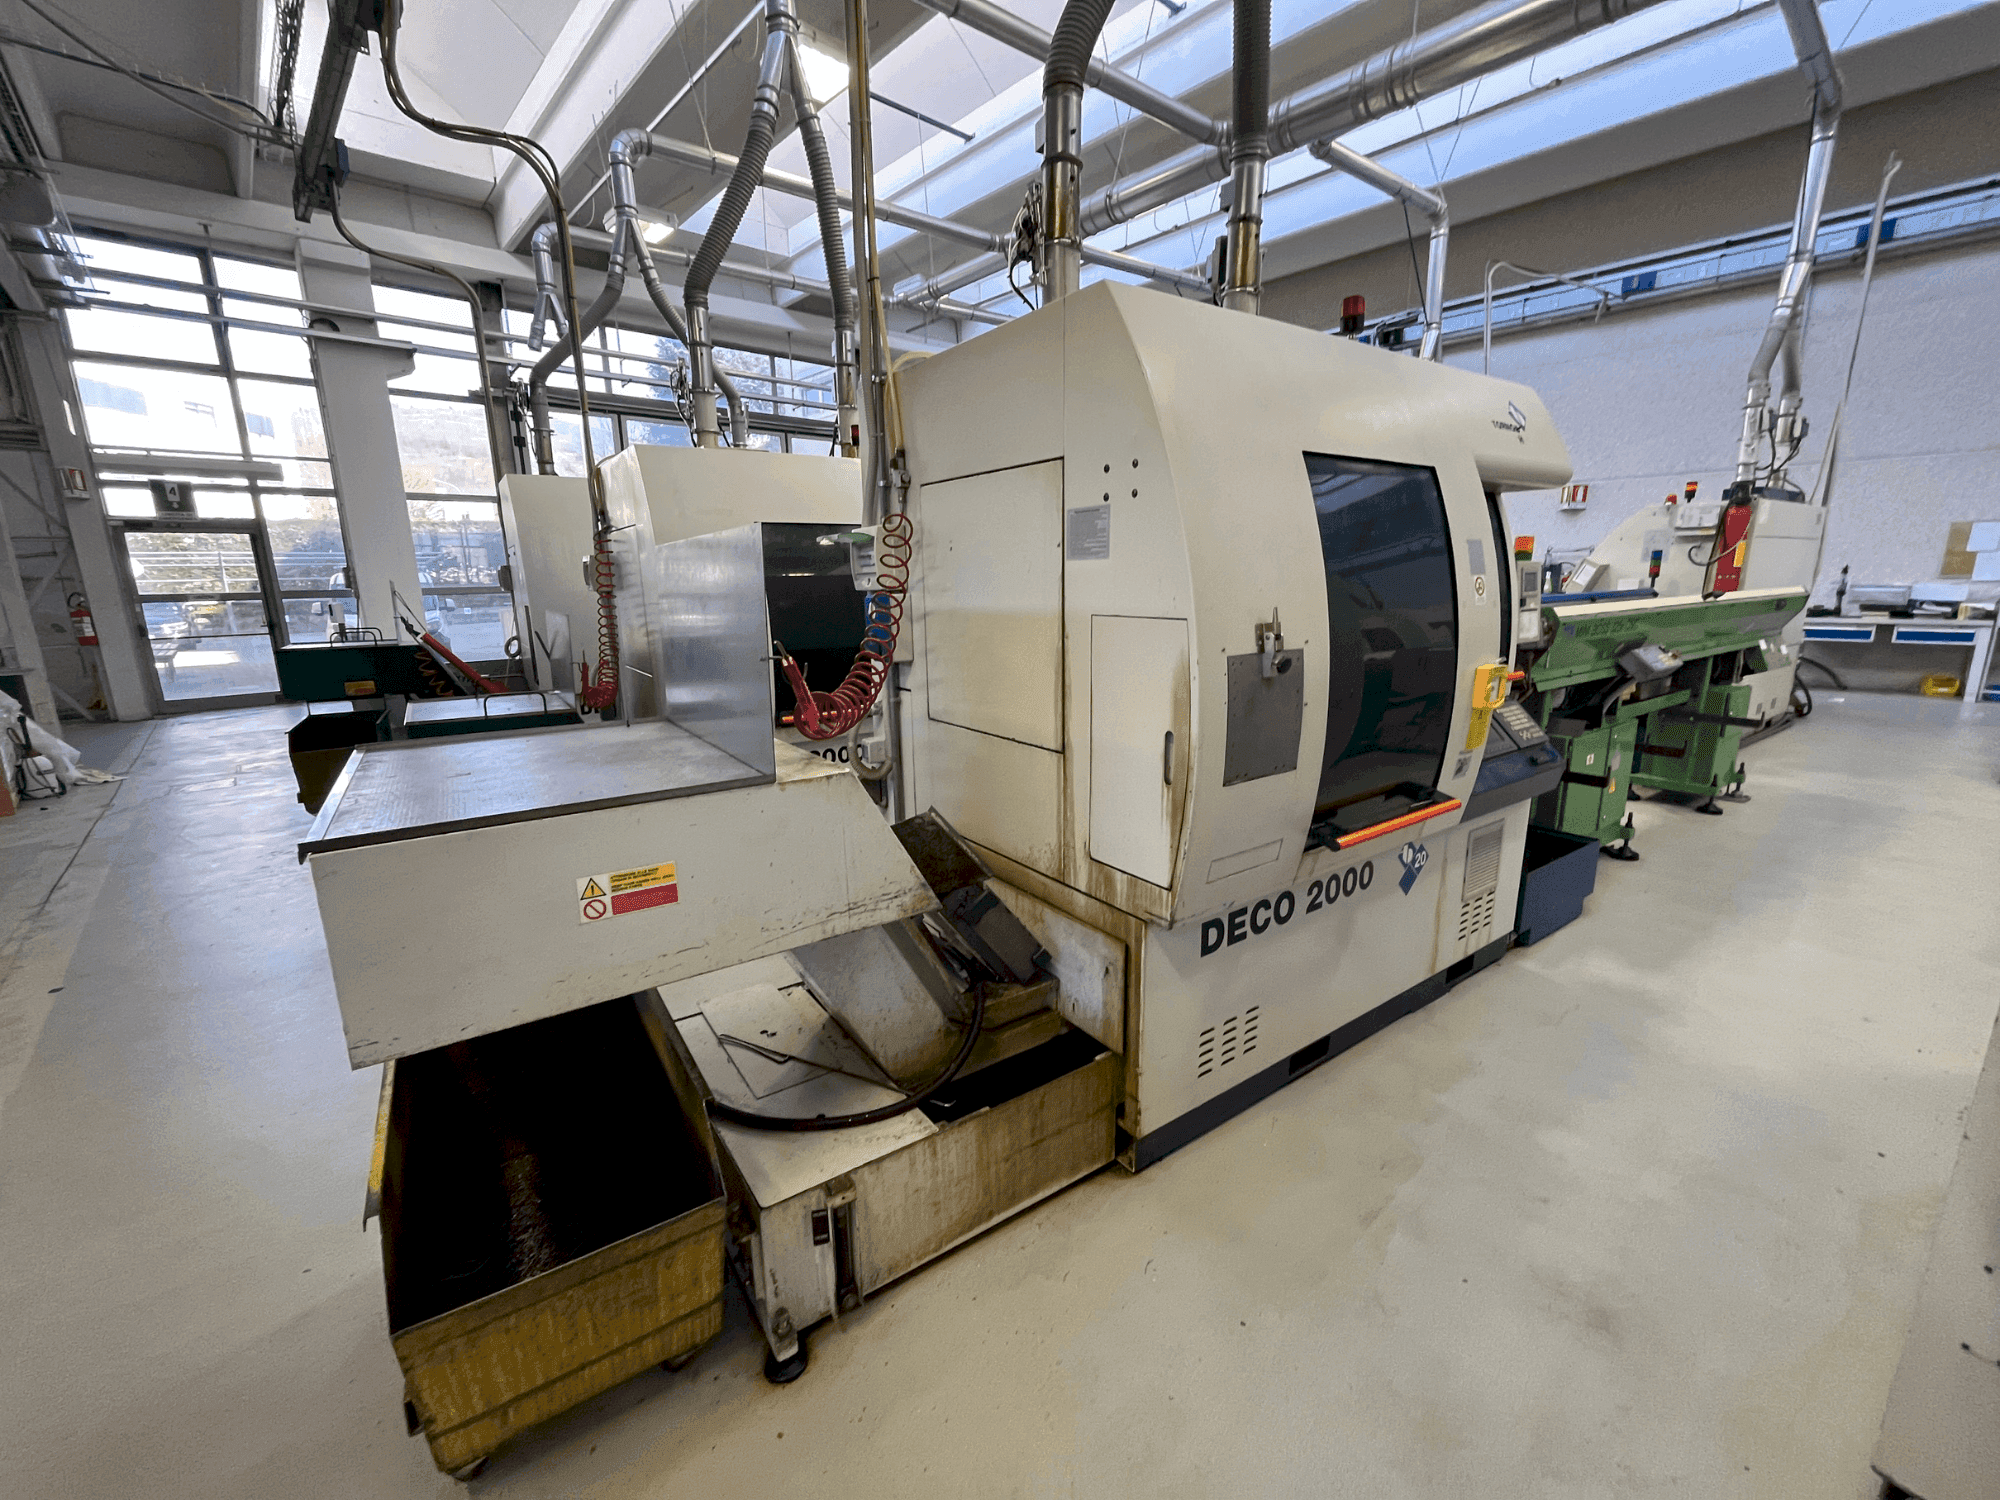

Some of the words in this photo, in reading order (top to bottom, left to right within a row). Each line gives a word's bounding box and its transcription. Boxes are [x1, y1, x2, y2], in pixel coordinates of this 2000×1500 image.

[169, 486, 177, 496] 4
[1414, 850, 1427, 868] 20
[1201, 890, 1295, 958] DECO
[1306, 860, 1374, 915] 2000
